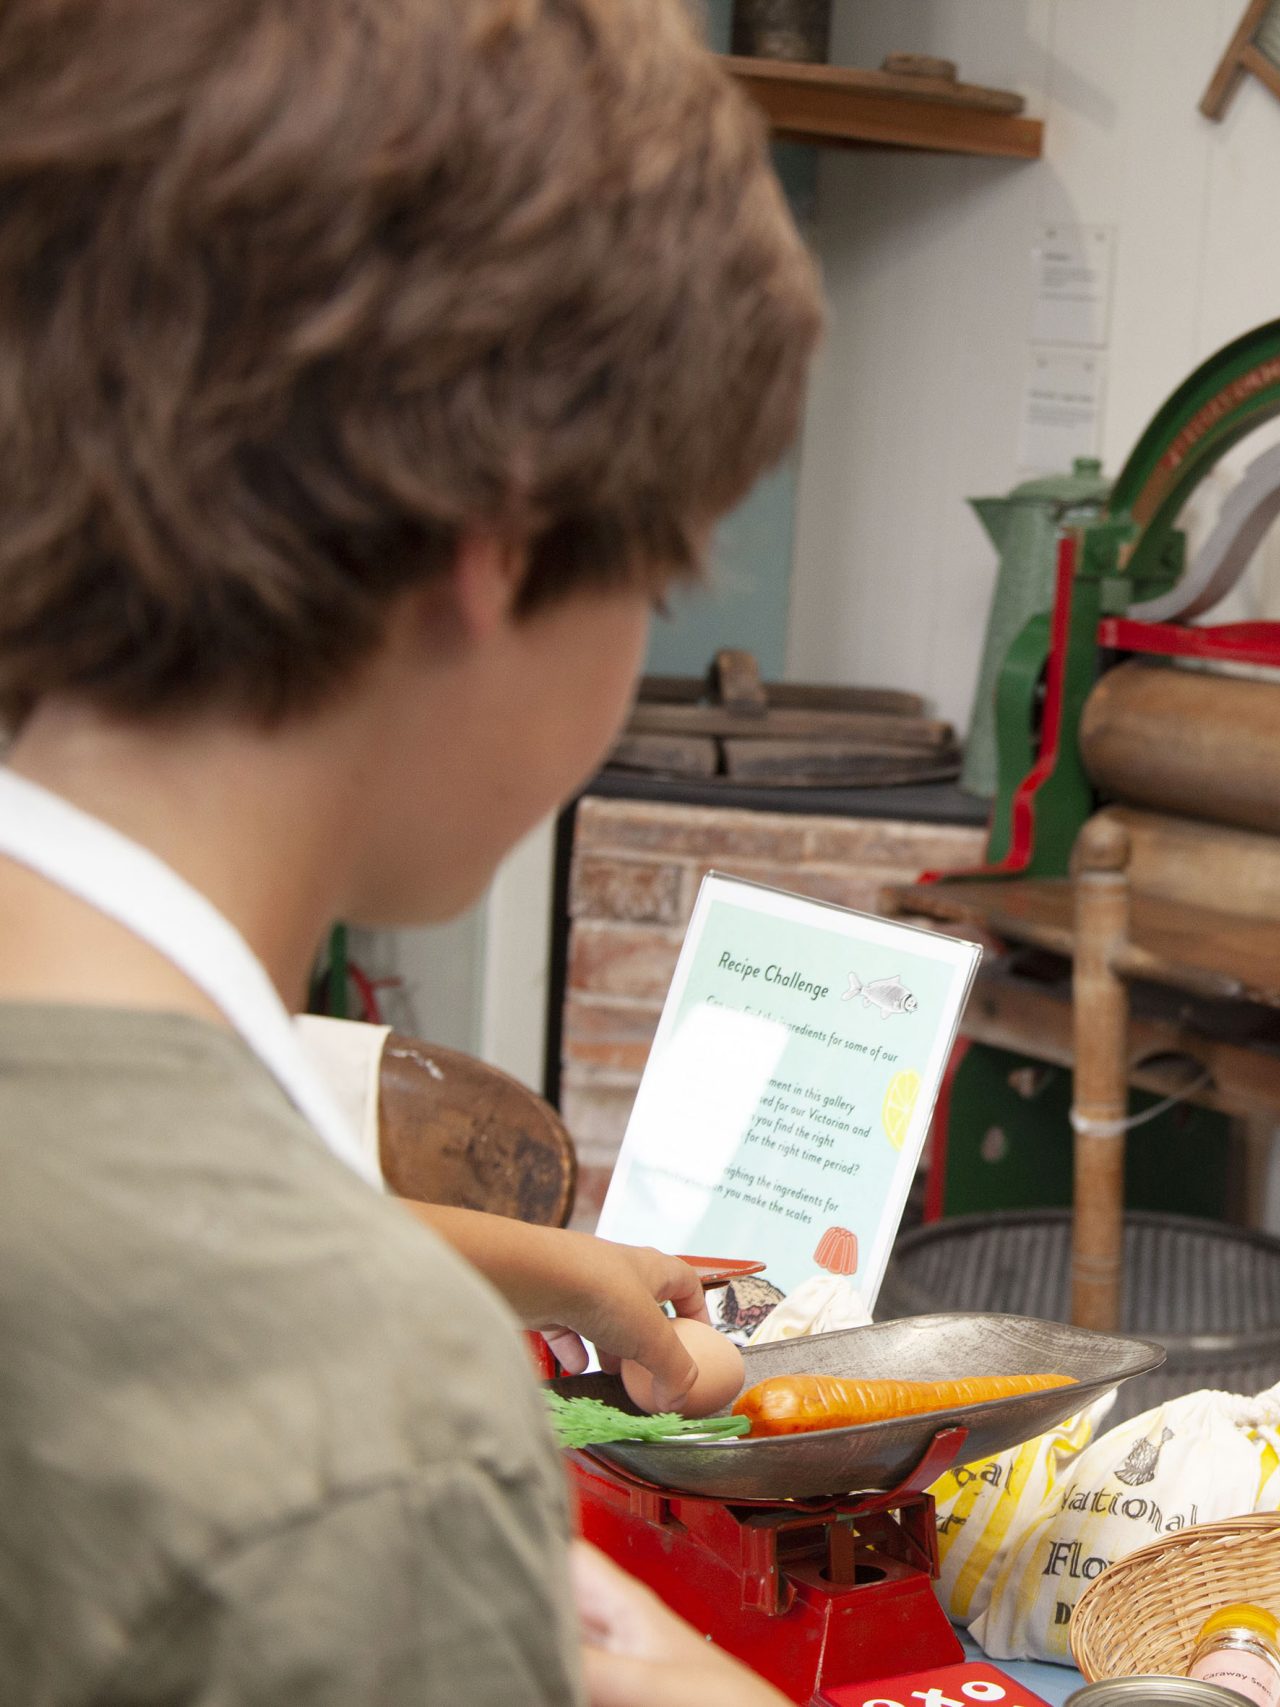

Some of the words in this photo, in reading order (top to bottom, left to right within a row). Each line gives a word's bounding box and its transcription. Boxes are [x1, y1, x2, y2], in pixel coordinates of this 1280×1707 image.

[718, 951, 760, 981] Recipe
[764, 965, 829, 1001] Challenge
[827, 1032, 843, 1047] for
[844, 1040, 868, 1054] some
[870, 1046, 882, 1061] of
[882, 1051, 898, 1063] our
[774, 1097, 789, 1112] for
[791, 1104, 805, 1117] our
[809, 1107, 850, 1132] Victorian
[852, 1126, 872, 1138] and
[793, 1082, 801, 1095] in
[804, 1088, 821, 1102] this
[823, 1095, 856, 1116] gallery
[756, 1115, 773, 1128] you
[773, 1117, 794, 1133] find
[795, 1126, 809, 1140] the
[811, 1131, 835, 1148] right
[744, 1129, 759, 1144] for
[760, 1135, 775, 1148] the
[777, 1140, 800, 1157] right
[801, 1149, 822, 1165] time
[823, 1158, 861, 1176] period?
[723, 1187, 741, 1199] you
[743, 1192, 767, 1208] make
[768, 1200, 783, 1213] the
[785, 1206, 812, 1224] scales
[756, 1174, 771, 1189] the
[773, 1179, 822, 1207] ingredients
[823, 1197, 839, 1213] for
[1042, 1538, 1115, 1580] Flo
[1202, 1671, 1248, 1681] Caraway
